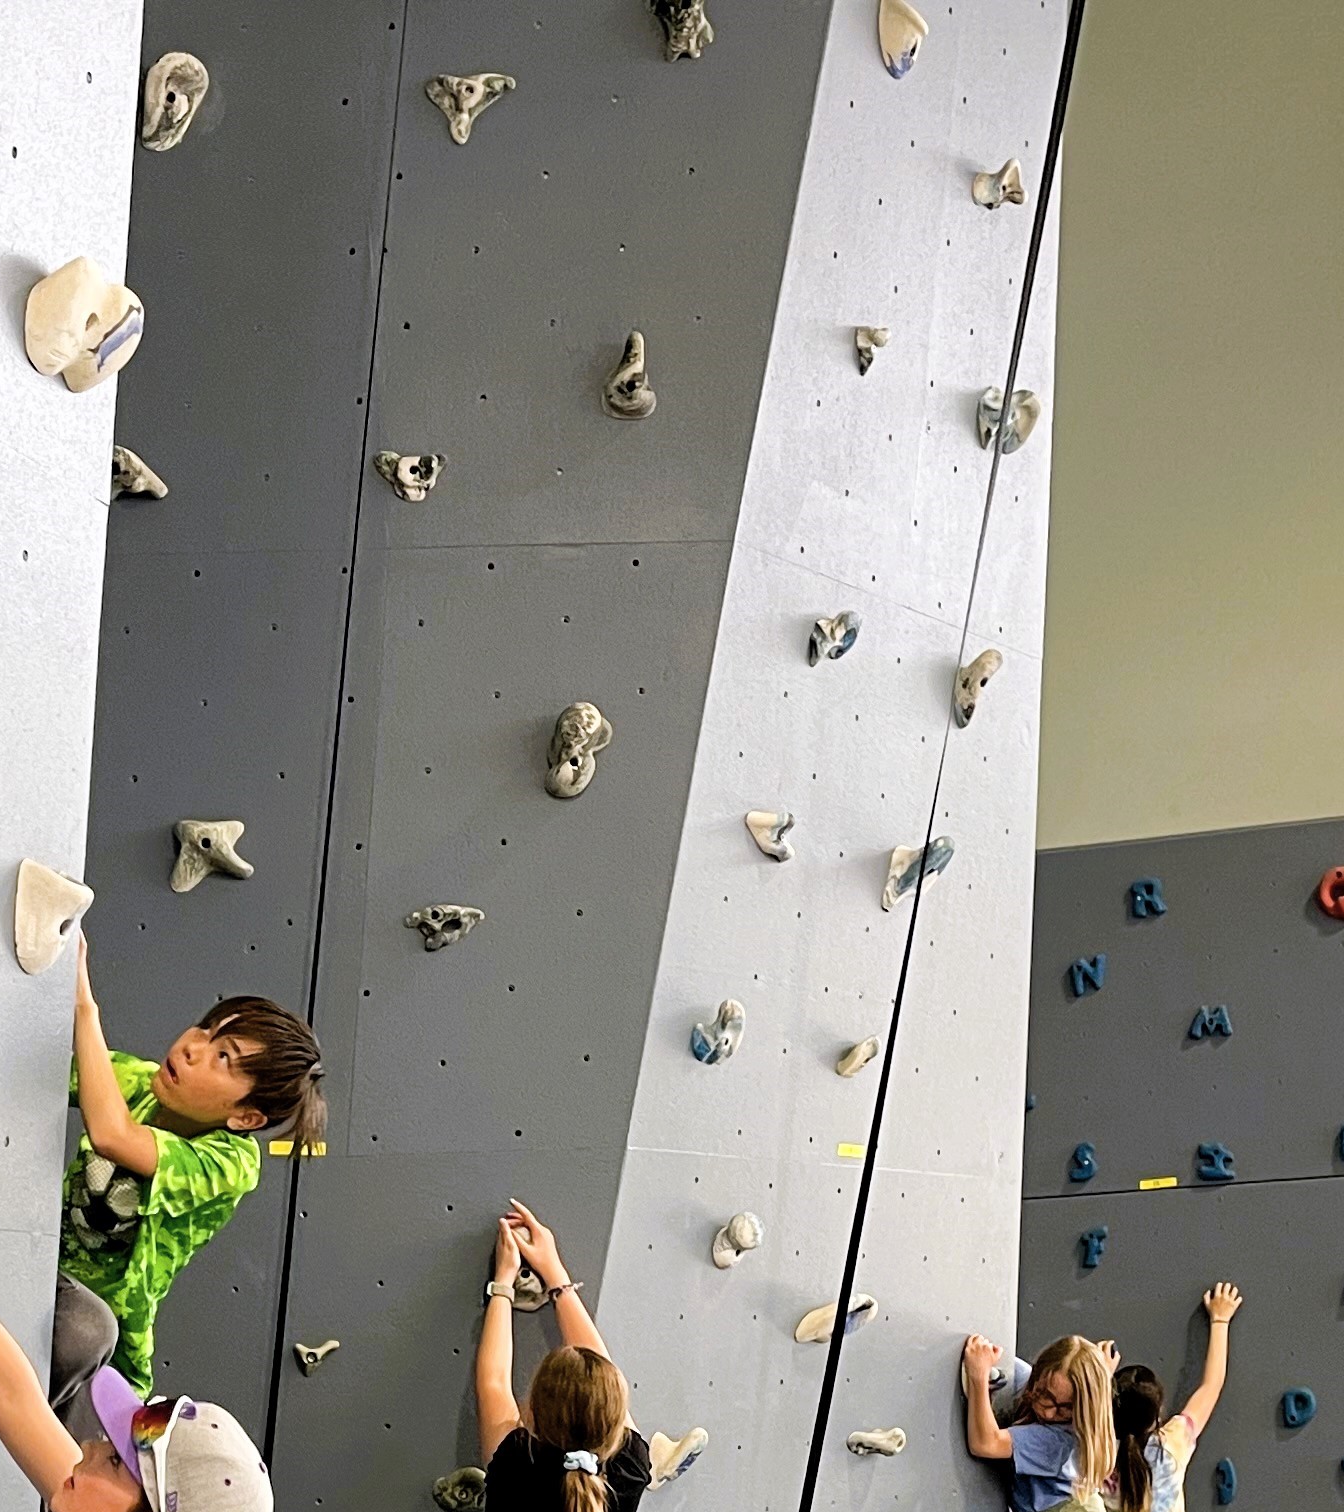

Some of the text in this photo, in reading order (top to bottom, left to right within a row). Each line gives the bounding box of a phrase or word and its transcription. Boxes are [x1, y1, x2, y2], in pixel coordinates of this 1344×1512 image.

[1130, 876, 1168, 918] R
[1069, 953, 1108, 997] N
[1189, 1004, 1233, 1040] M
[1068, 1141, 1099, 1182] S
[1282, 1385, 1318, 1429] D
